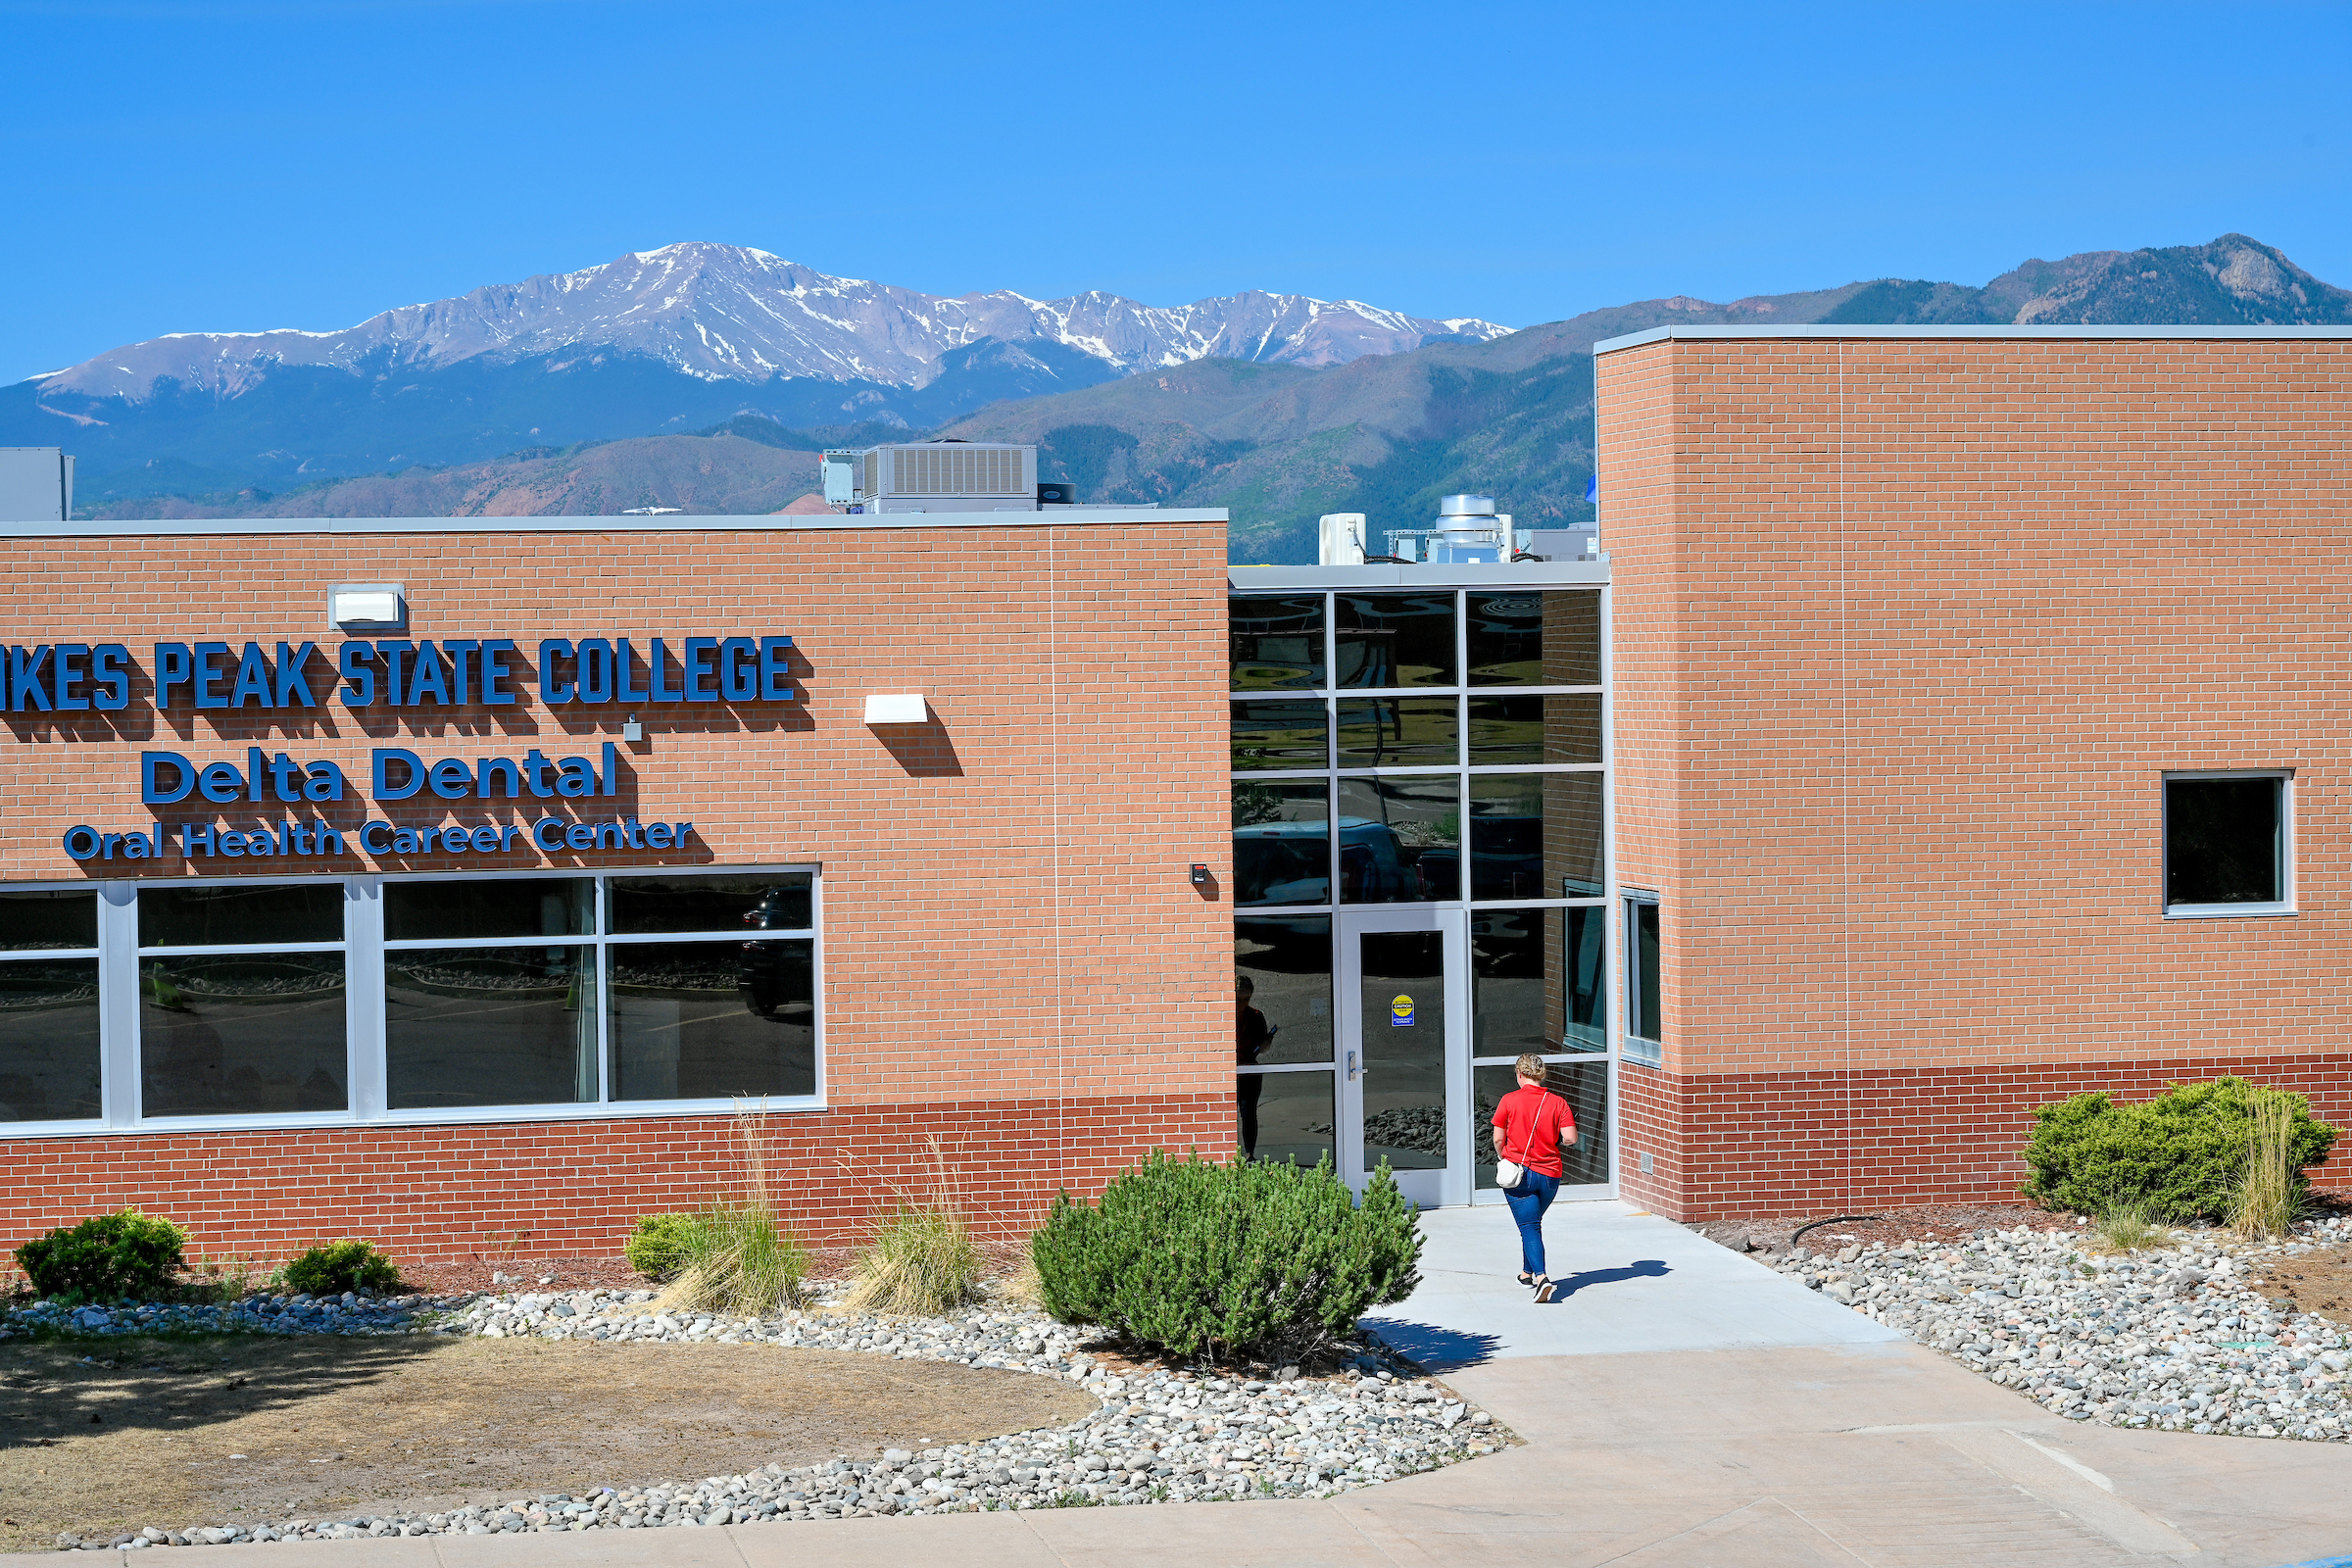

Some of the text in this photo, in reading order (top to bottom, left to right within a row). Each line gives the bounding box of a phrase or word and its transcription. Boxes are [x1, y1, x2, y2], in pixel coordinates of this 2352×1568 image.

[154, 641, 318, 710] PEAK
[339, 639, 516, 708] STATE
[538, 635, 795, 705] COLLEGE
[141, 741, 616, 806] Delta Dental
[63, 816, 693, 860] Oral Health Career Center
